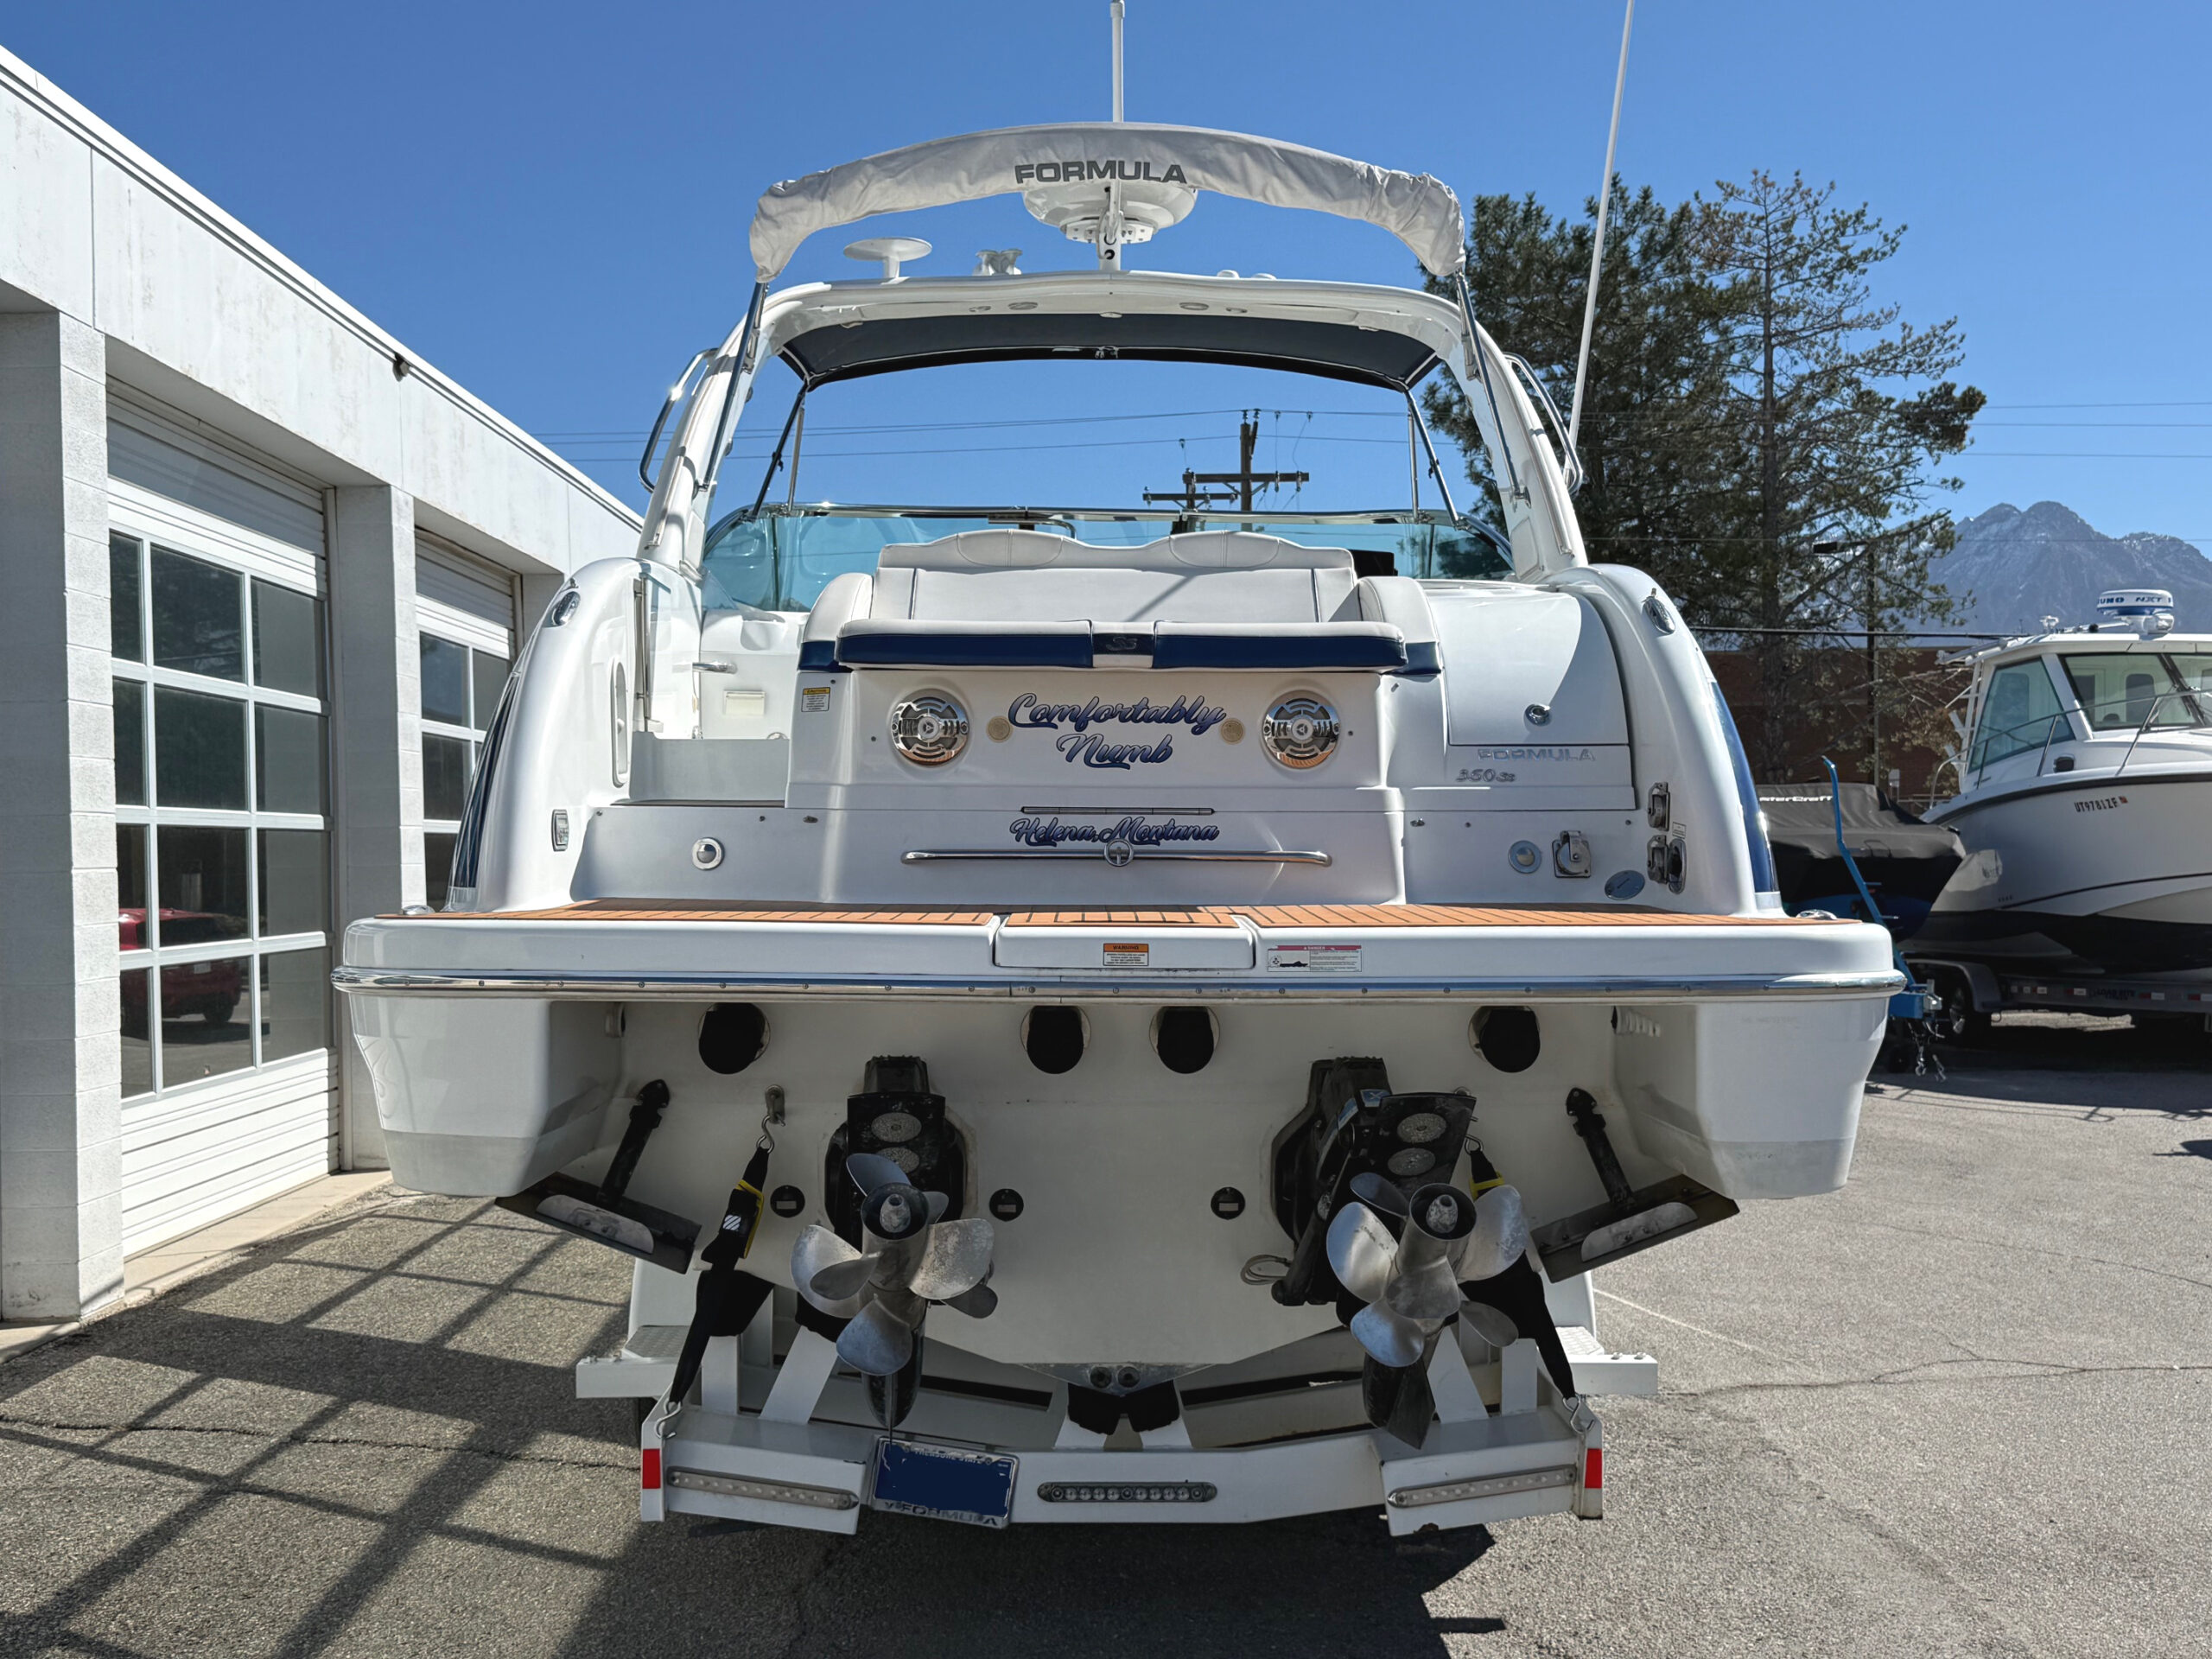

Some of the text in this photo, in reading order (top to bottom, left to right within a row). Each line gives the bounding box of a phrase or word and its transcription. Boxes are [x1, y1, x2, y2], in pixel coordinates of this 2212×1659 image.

[1014, 160, 1187, 184] FORMULA
[1008, 693, 1226, 735] Comfortably
[1056, 733, 1173, 770] Numb
[1478, 748, 1596, 761] FORMULA
[1009, 817, 1220, 847] Helena, Montana
